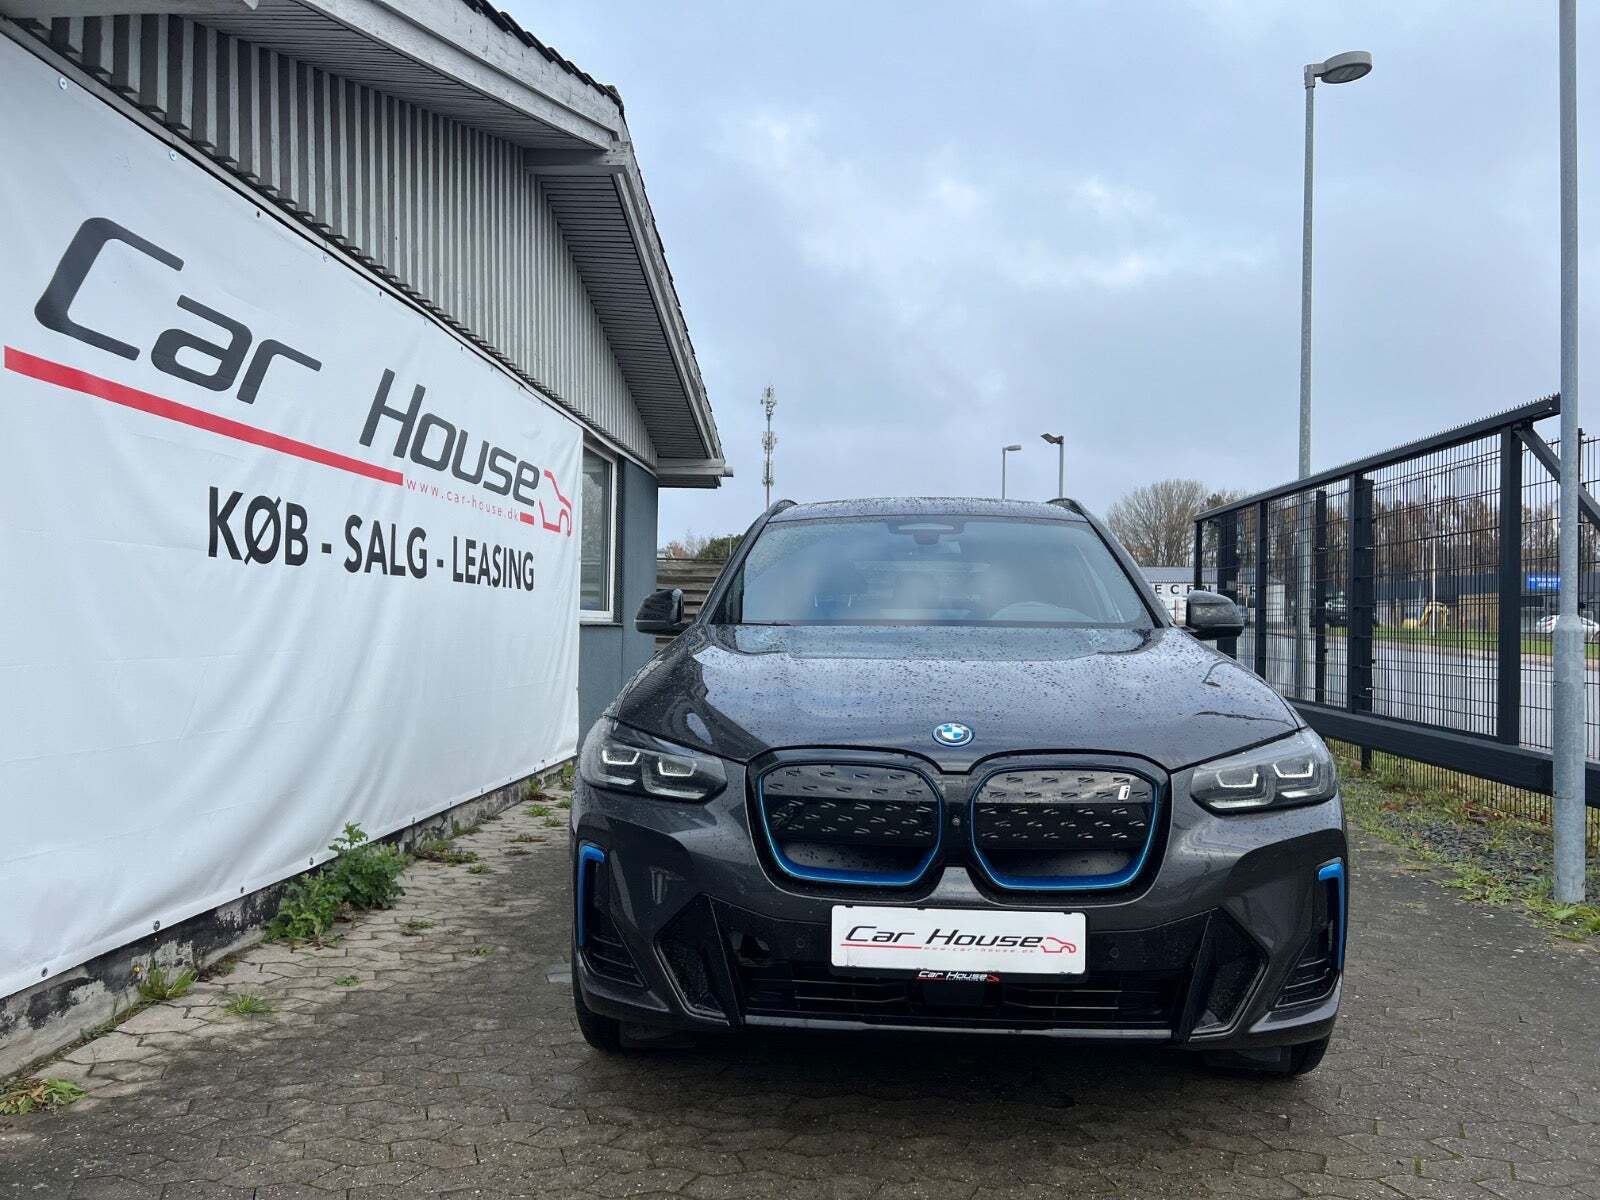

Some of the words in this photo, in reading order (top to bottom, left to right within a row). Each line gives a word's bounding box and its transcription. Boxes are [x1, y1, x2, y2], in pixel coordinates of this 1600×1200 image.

[34, 217, 322, 404] Car
[358, 368, 539, 506] House
[406, 479, 519, 521] www.car-house.dk
[208, 486, 309, 566] KØB
[344, 514, 428, 580] SALG
[452, 535, 534, 592] LEASING
[845, 926, 915, 943] Car
[925, 928, 1044, 948] House
